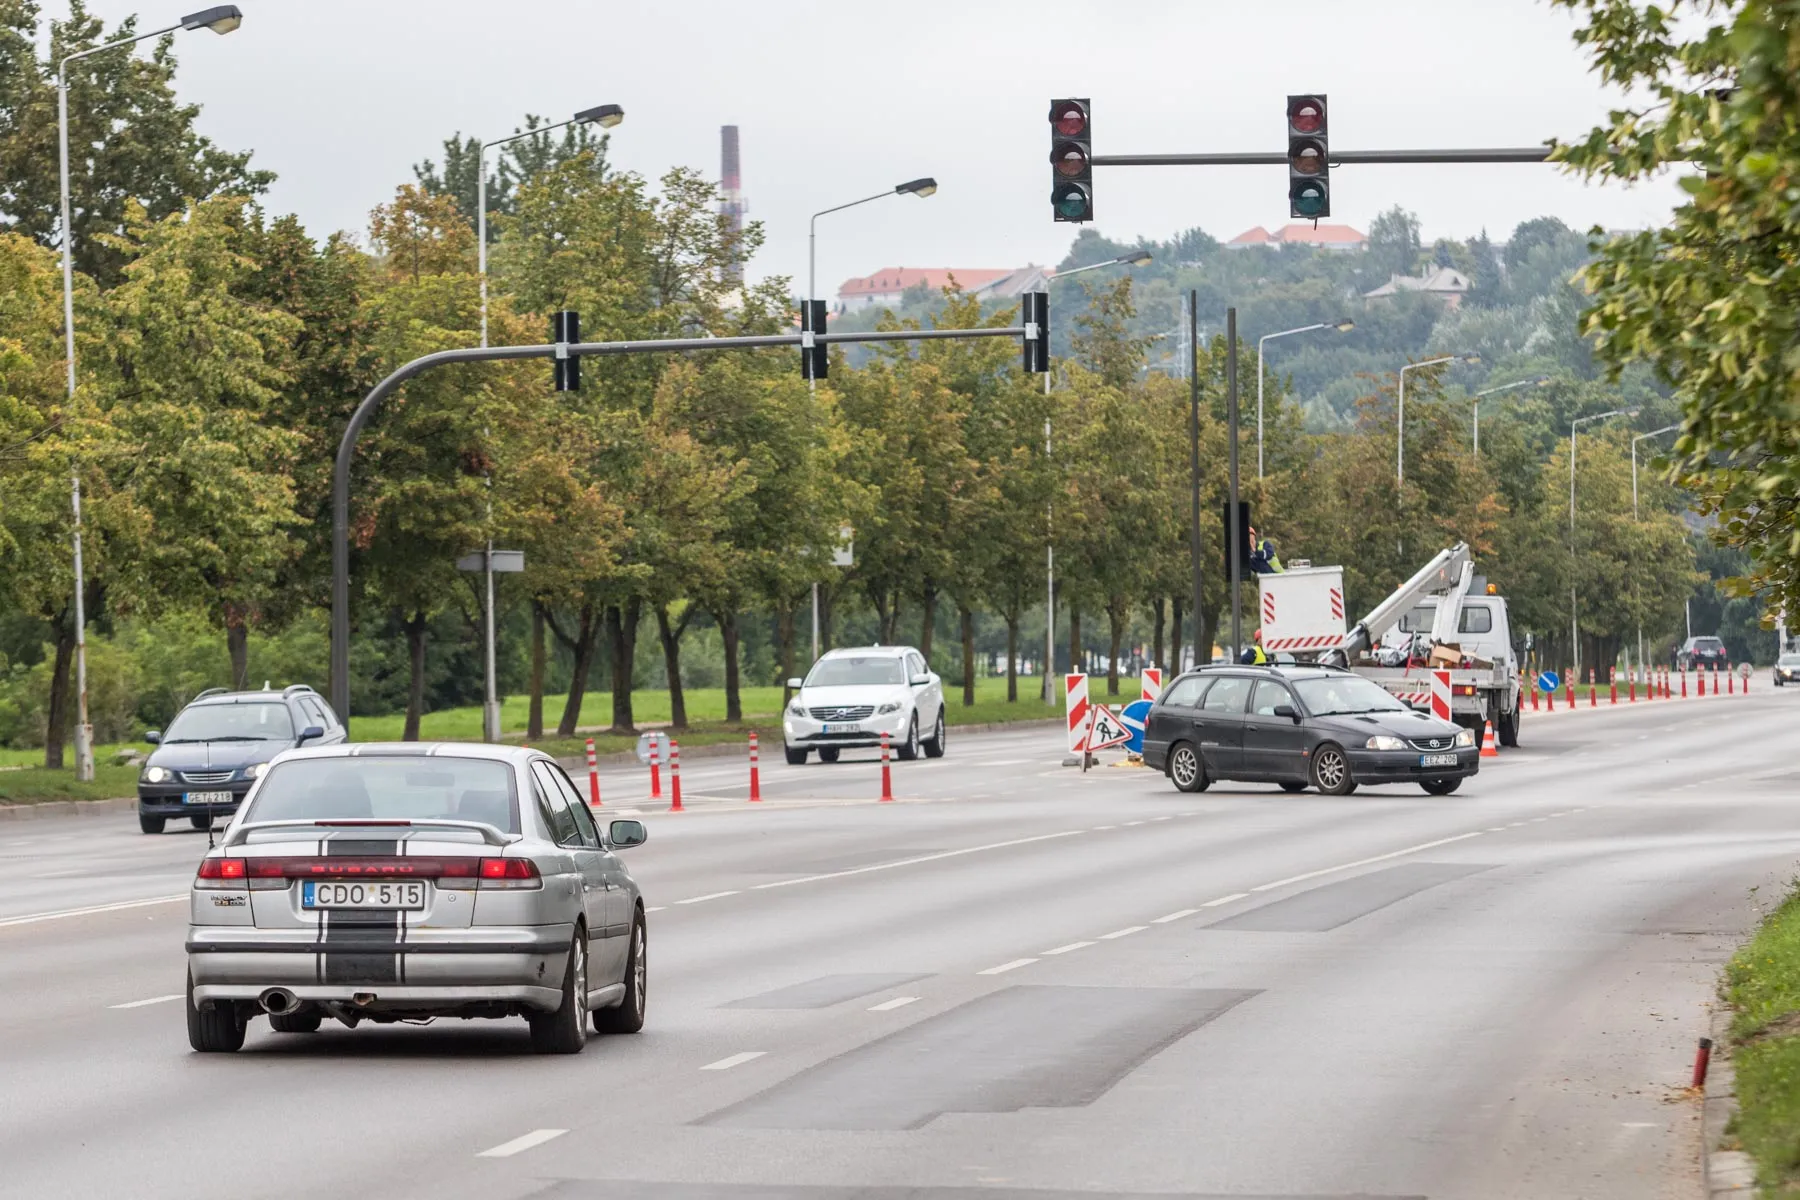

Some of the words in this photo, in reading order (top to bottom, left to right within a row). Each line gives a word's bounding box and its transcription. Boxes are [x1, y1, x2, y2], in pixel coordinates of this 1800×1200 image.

[1424, 756, 1440, 765] EEZ
[189, 793, 207, 802] GET
[213, 792, 232, 802] 218
[311, 865, 414, 873] SUBARU
[318, 884, 364, 904] CDO
[379, 885, 419, 904] 515
